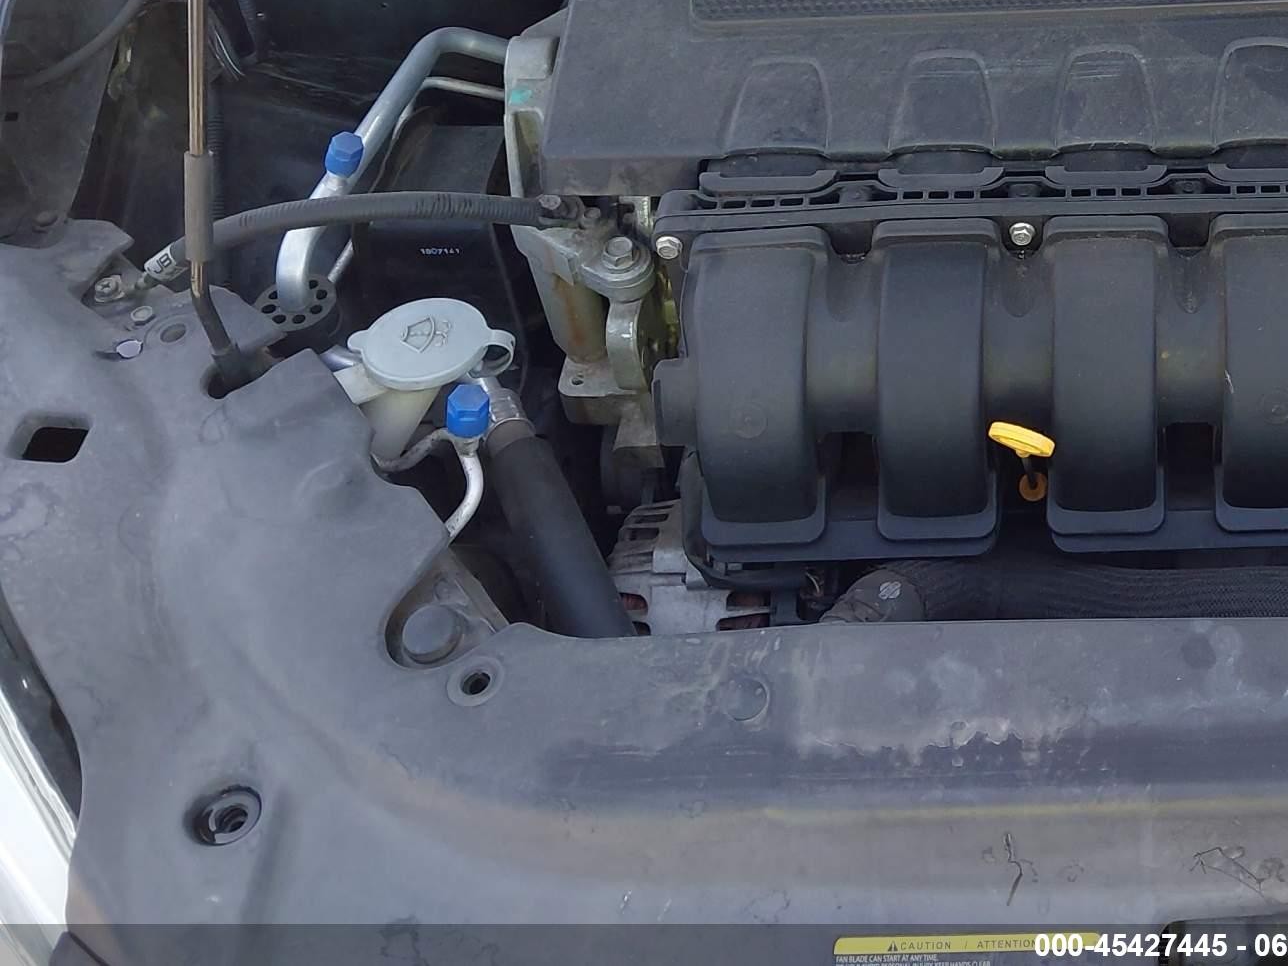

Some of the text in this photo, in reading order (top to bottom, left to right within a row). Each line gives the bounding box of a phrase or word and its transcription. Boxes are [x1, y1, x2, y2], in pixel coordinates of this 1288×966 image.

[900, 941, 951, 951] CAUTION
[835, 955, 848, 964] FAN
[848, 955, 868, 963] BLADE
[868, 954, 882, 963] CAN
[882, 954, 901, 963] START
[901, 954, 910, 962] AT
[910, 954, 922, 962] ANY
